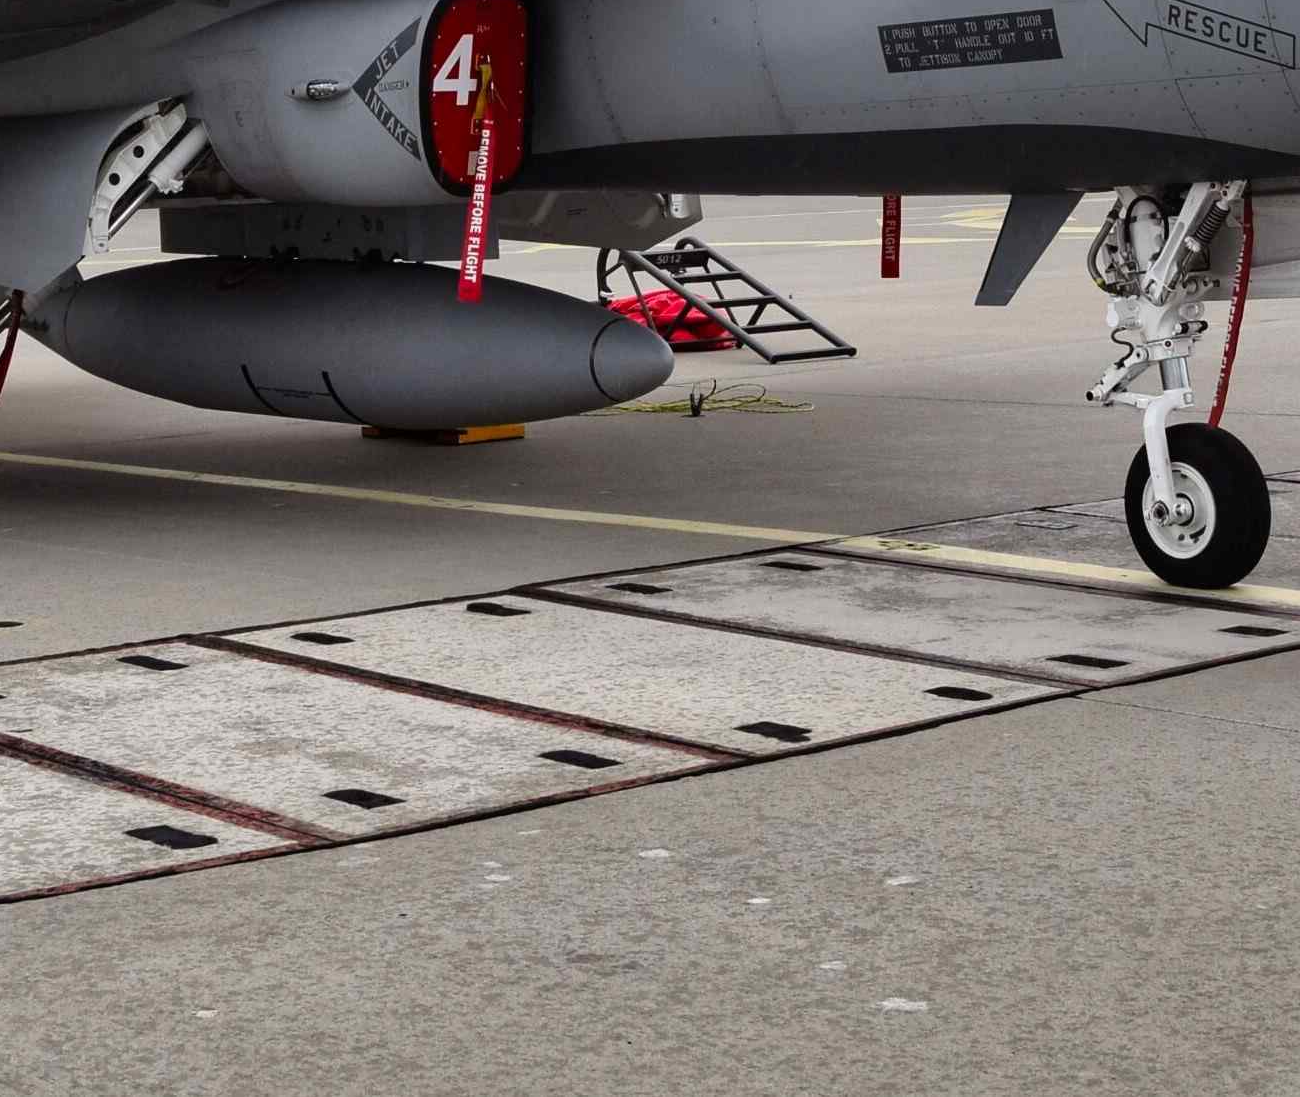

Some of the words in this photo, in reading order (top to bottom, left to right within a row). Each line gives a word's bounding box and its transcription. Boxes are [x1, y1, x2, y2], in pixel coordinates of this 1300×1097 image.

[891, 27, 916, 40] PUSH
[922, 22, 957, 37] BUTTON
[964, 21, 978, 33] TO
[985, 18, 1010, 31] OPEN
[1016, 14, 1043, 28] DOOR
[895, 41, 919, 54] PULL
[954, 34, 992, 49] HANDLE
[997, 31, 1016, 45] OUT
[1167, 4, 1267, 54] RESCUE
[375, 41, 399, 80] JET
[432, 34, 478, 106] 4
[899, 57, 912, 70] TO
[364, 86, 417, 152] INTAKE
[475, 129, 491, 181] REMOVE
[469, 184, 486, 234] BEFORE
[464, 236, 481, 283] FLIGHT
